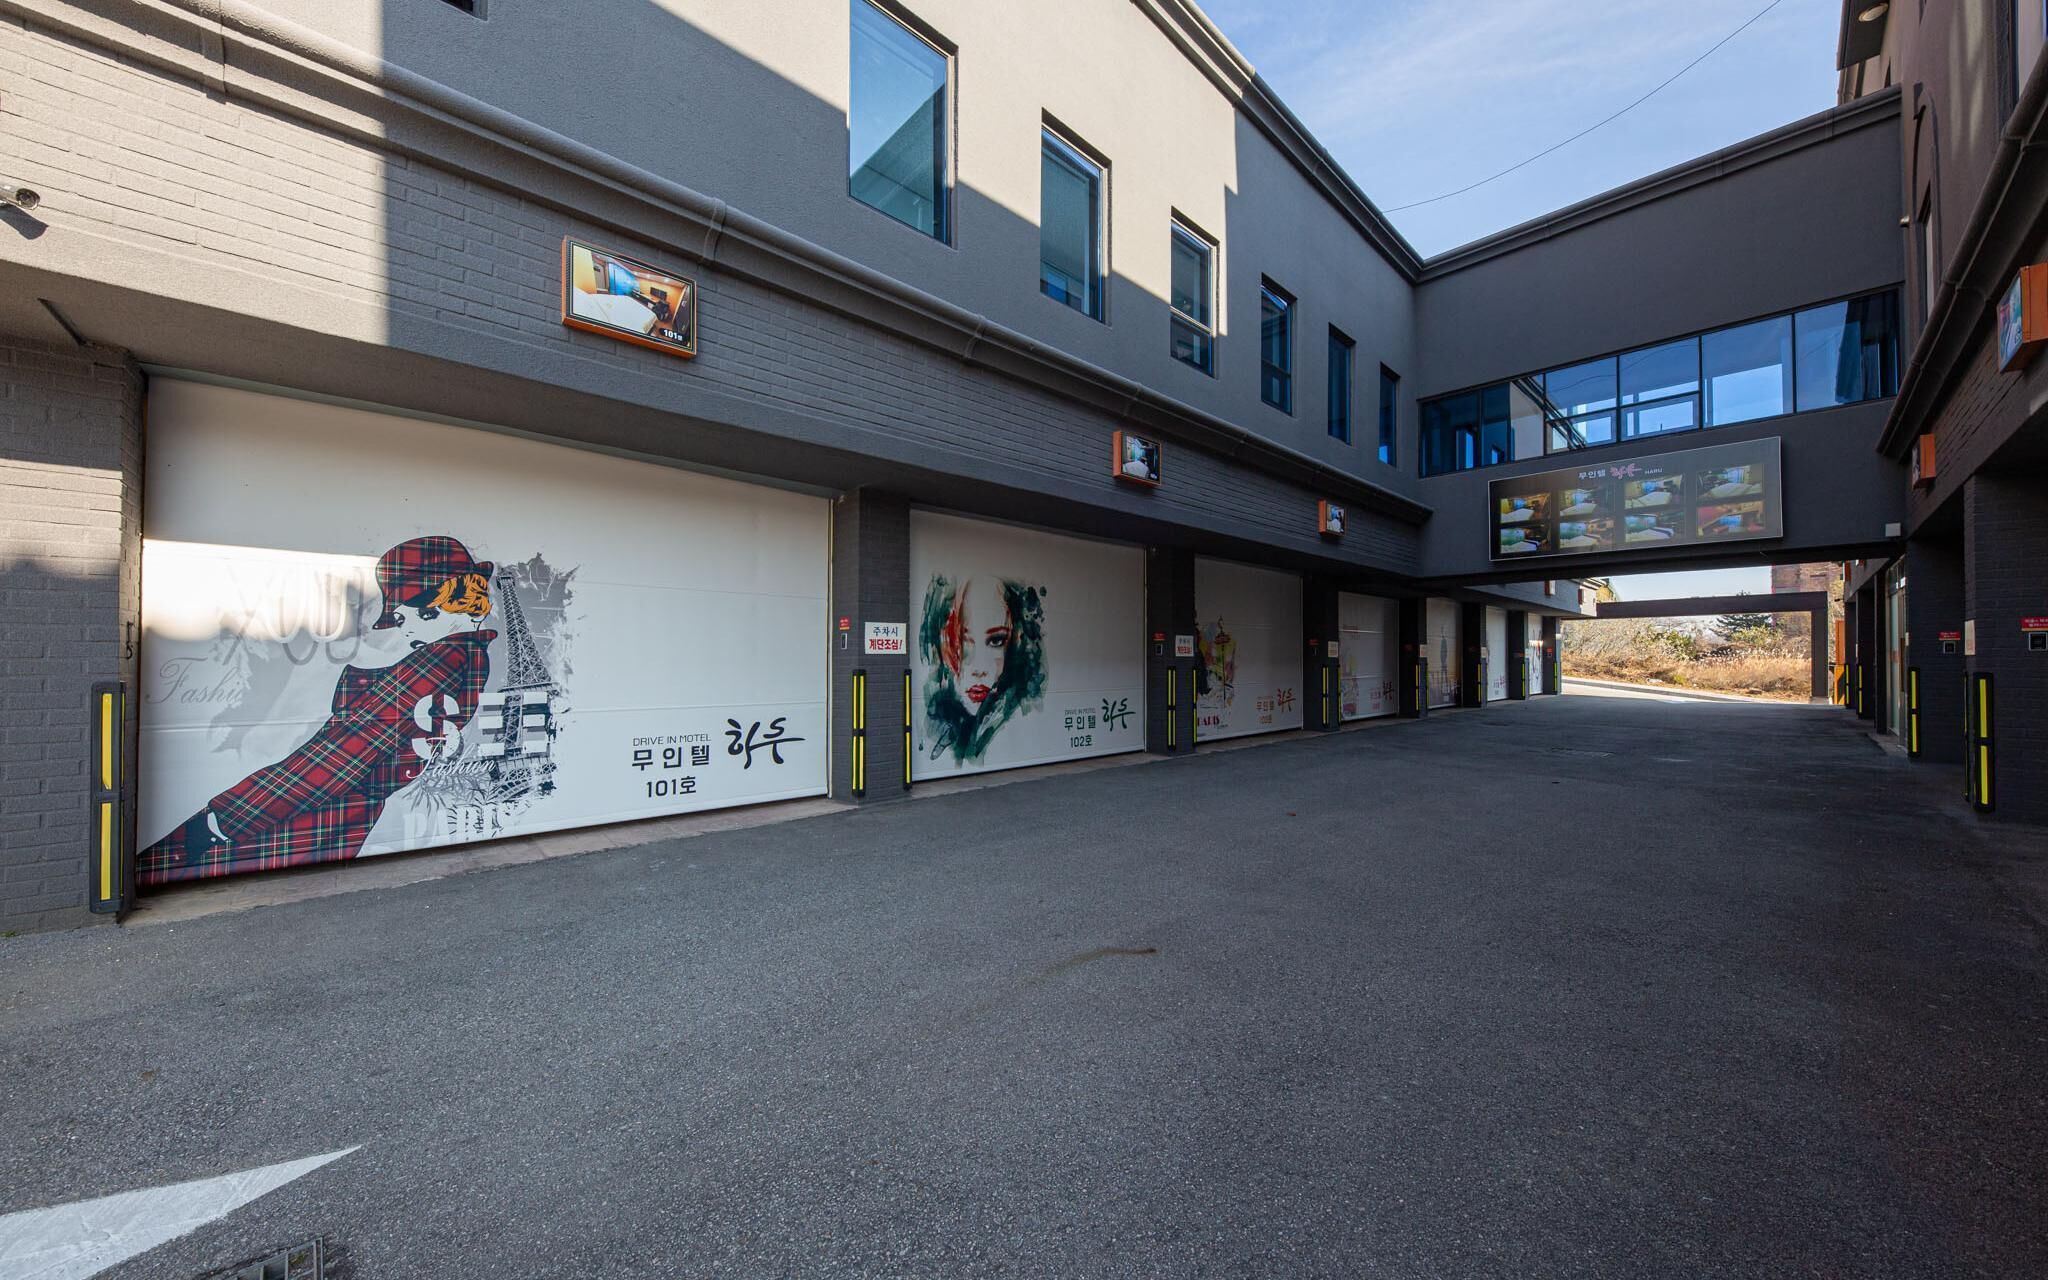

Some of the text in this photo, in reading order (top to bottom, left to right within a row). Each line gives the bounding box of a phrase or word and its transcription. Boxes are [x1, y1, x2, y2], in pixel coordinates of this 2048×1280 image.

[873, 626, 899, 637] 주차시
[869, 638, 903, 651] 계단조심!
[1101, 697, 1137, 732] 하루
[1064, 715, 1096, 731] 무인텔
[632, 733, 711, 747] DRIVE IN MOTEL
[724, 716, 806, 770] 하루
[1070, 734, 1093, 748] 102호
[631, 744, 710, 772] 무인텔
[646, 775, 697, 799] 101호
